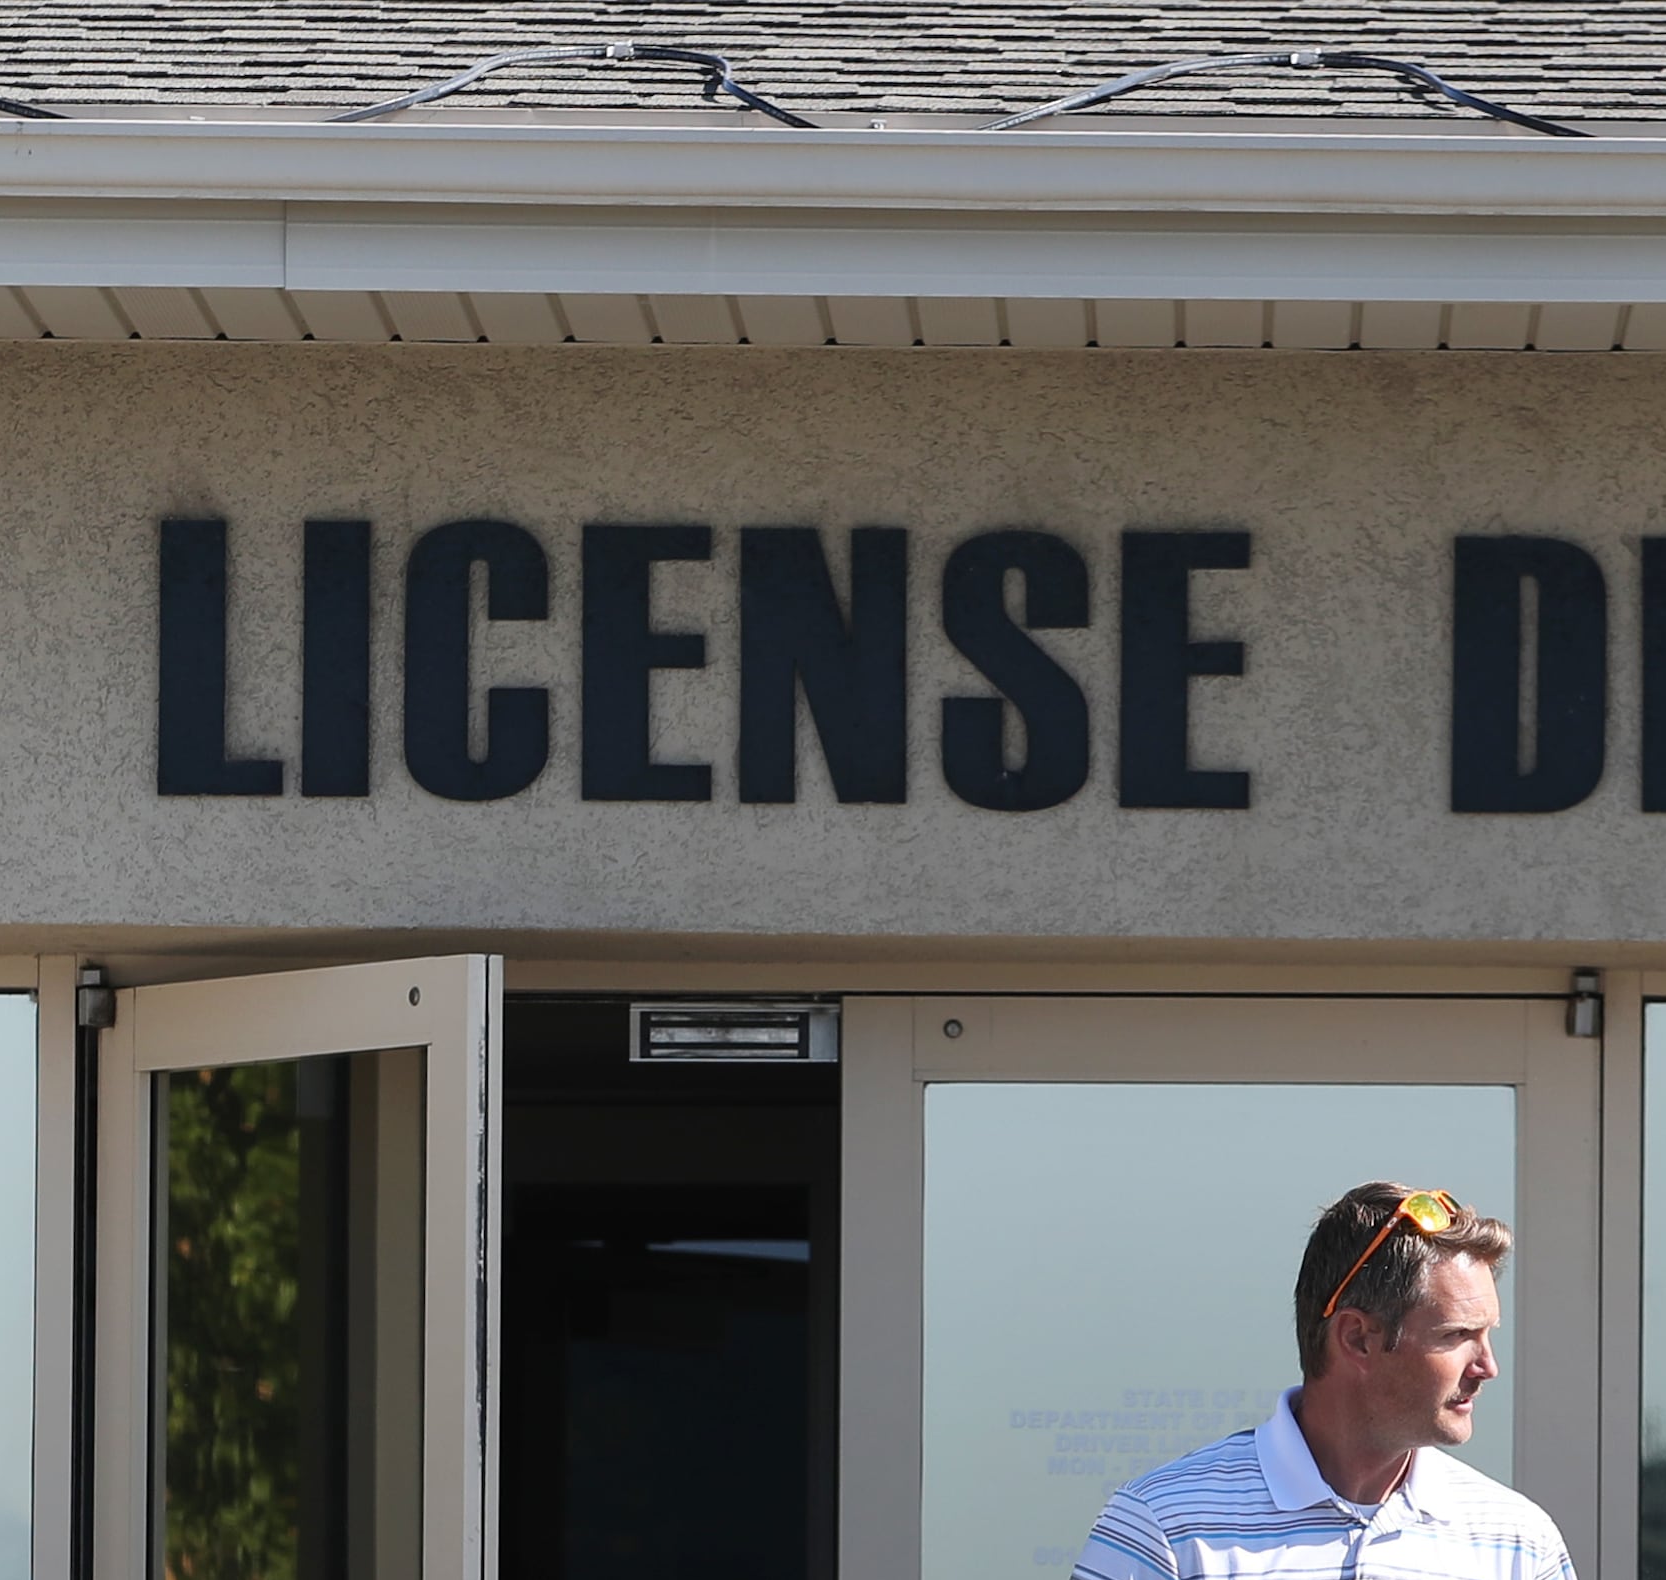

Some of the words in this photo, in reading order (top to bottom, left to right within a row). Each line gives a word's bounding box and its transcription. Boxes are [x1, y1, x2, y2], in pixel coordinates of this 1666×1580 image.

[158, 519, 1251, 812] LICENSE
[1009, 1408, 1184, 1430] DEPARTMENT
[1054, 1433, 1150, 1454] DRIVER
[1046, 1456, 1106, 1476] MON
